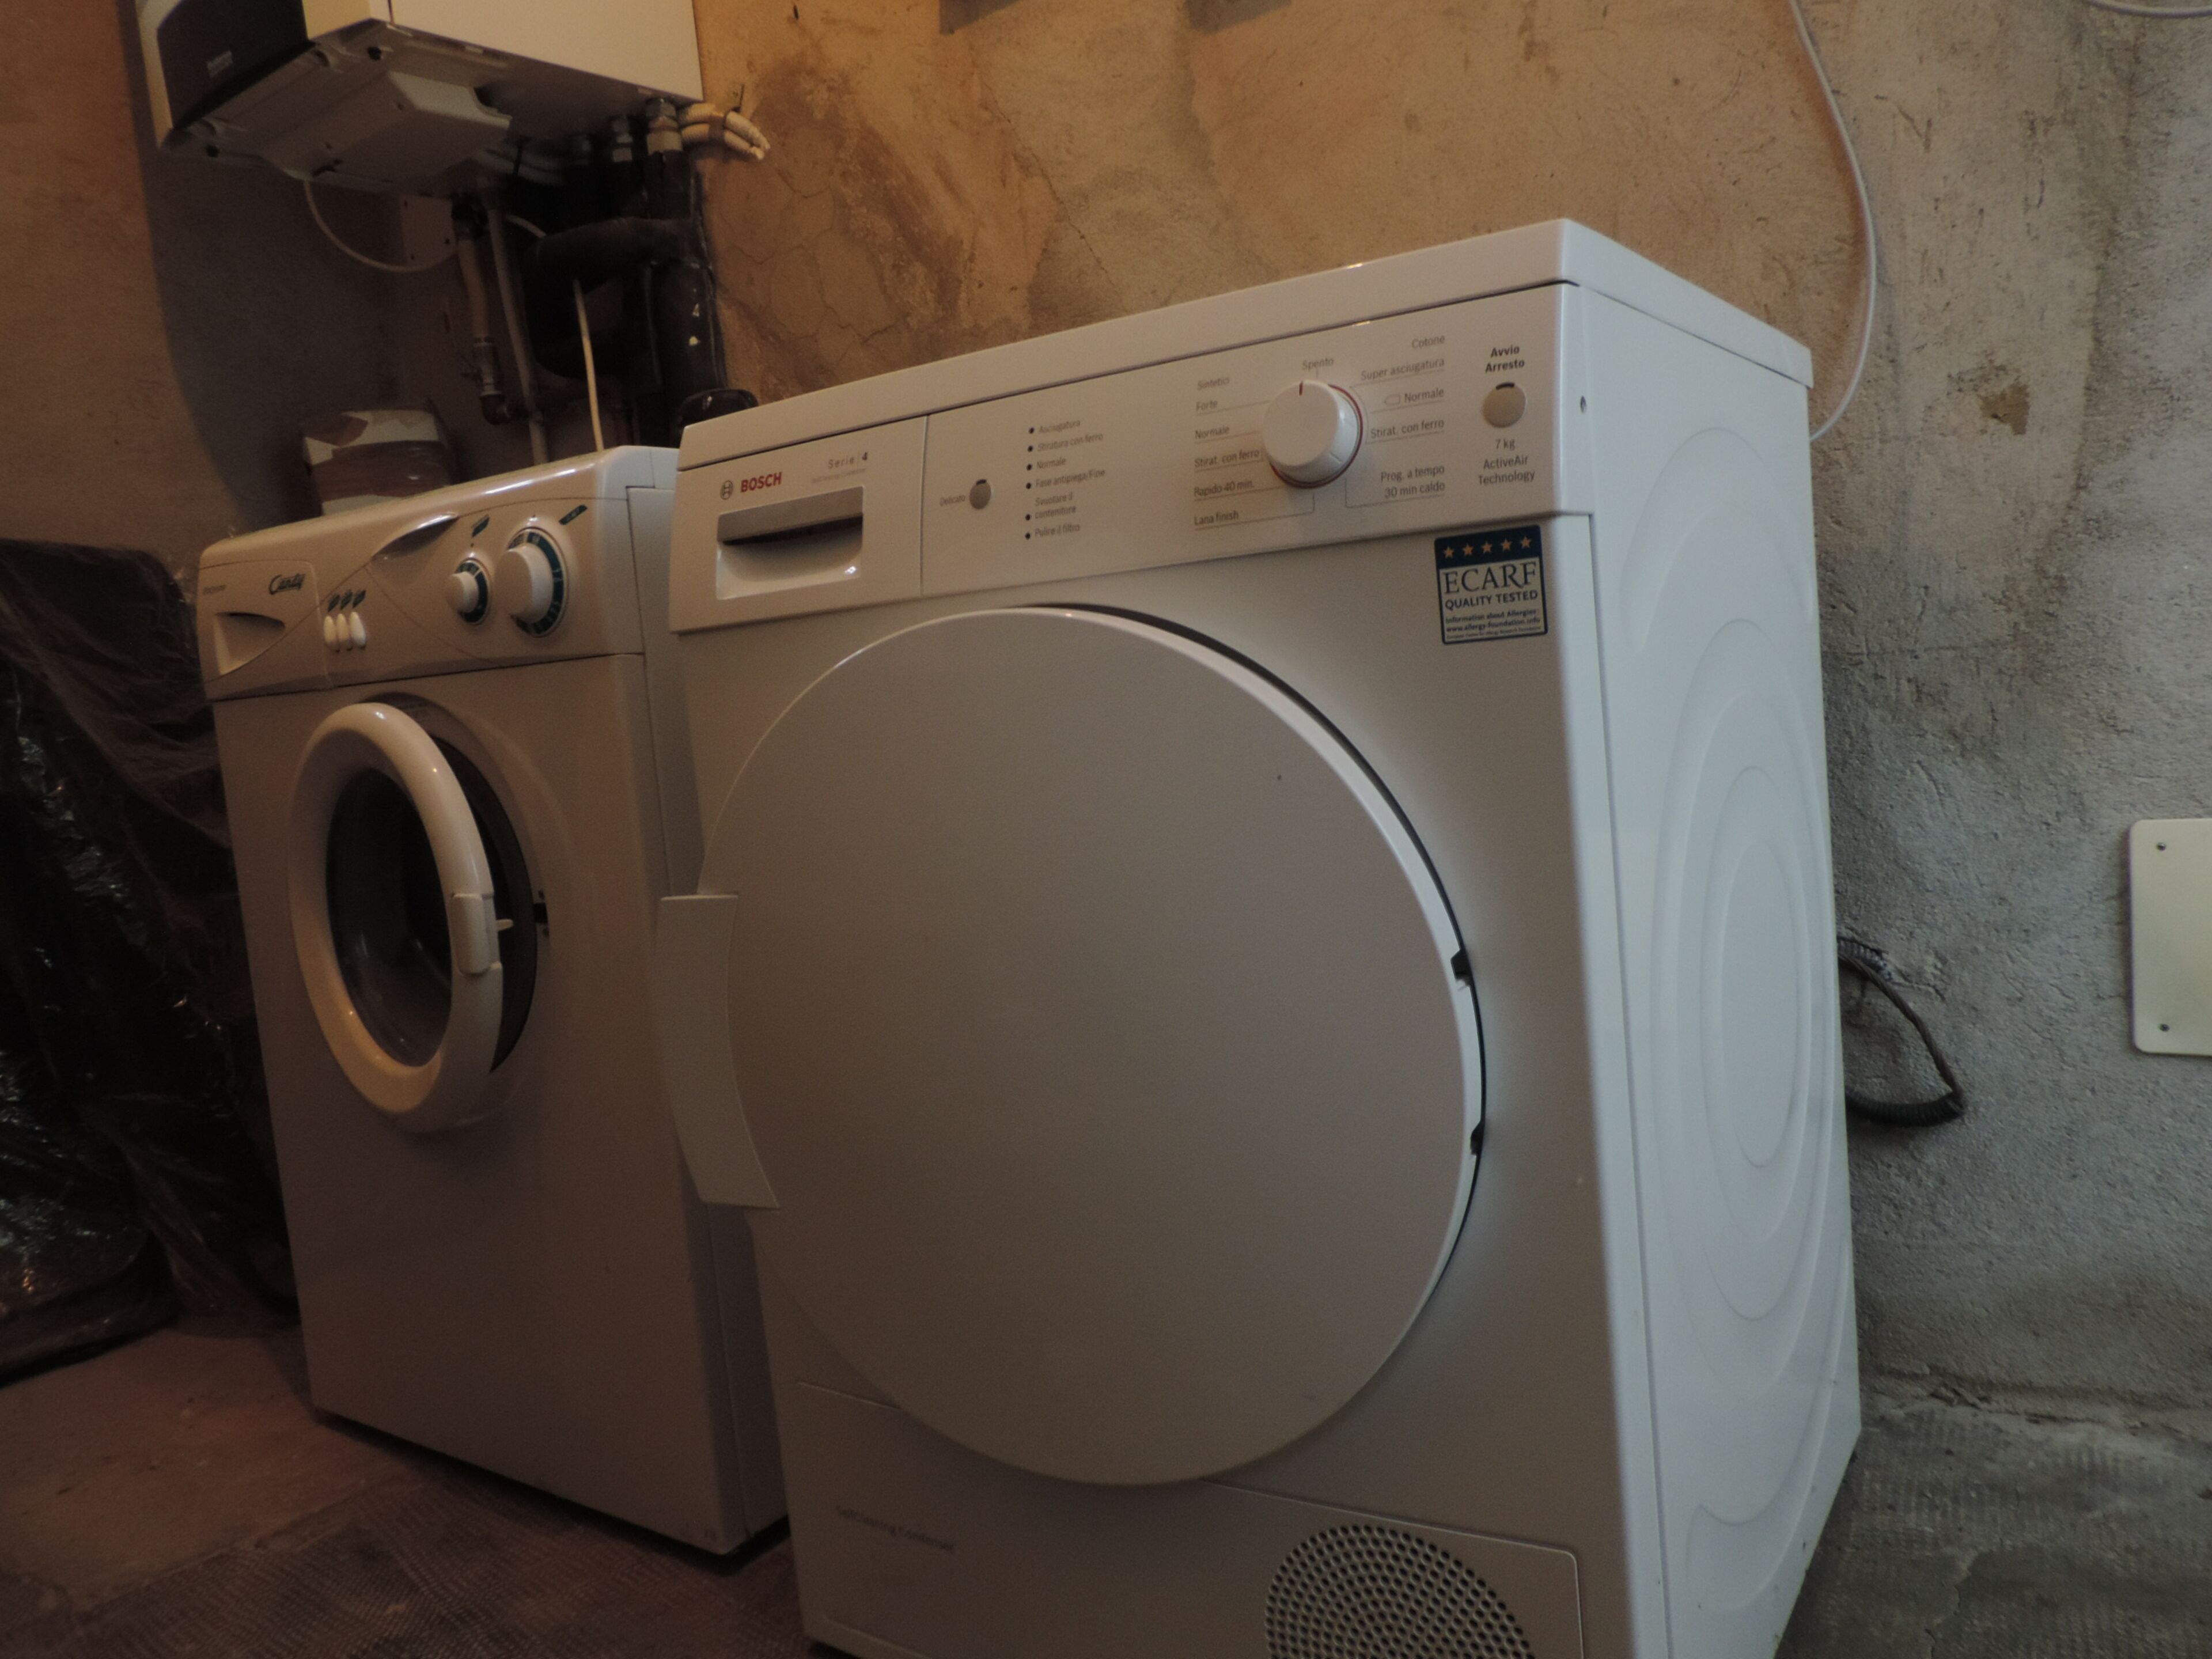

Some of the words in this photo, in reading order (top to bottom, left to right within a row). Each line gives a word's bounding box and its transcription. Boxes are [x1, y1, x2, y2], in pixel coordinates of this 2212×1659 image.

[1412, 335, 1445, 349] Cotone
[1490, 345, 1520, 358] Avvio
[1302, 357, 1334, 371] Spento
[1361, 367, 1388, 381] Super
[1390, 358, 1445, 376] asciugatura
[1485, 359, 1525, 373] Arresto
[1197, 377, 1230, 390] Sintetici
[1404, 388, 1444, 402] Normale
[1196, 399, 1218, 411] Forte
[1195, 425, 1230, 440] Normale
[1401, 424, 1419, 434] con
[1421, 419, 1444, 430] ferro
[1037, 440, 1069, 452] Stiratura
[1070, 437, 1084, 446] con
[1085, 433, 1104, 444] ferro
[1495, 439, 1501, 449] 7
[1503, 438, 1516, 451] kg
[828, 456, 854, 469] Serie
[861, 451, 869, 461] 4
[1037, 456, 1066, 469] Normale
[1222, 453, 1237, 464] con
[1239, 449, 1260, 460] ferro
[1483, 454, 1528, 470] ActiveAir
[1407, 471, 1413, 479] a
[1415, 465, 1445, 479] tempo
[1478, 470, 1535, 486] Technology
[740, 472, 782, 493] BOSCH
[1035, 477, 1052, 488] Fase
[1194, 482, 1223, 497] Rapido
[1225, 480, 1235, 491] 40
[1237, 479, 1253, 490] min
[1385, 487, 1397, 499] 30
[1400, 484, 1417, 495] min
[1419, 481, 1445, 493] caldo
[940, 494, 966, 507] Delicato
[1035, 494, 1066, 506] Svuotare
[1194, 514, 1214, 525] Lana
[1215, 509, 1239, 522] finish
[1035, 527, 1055, 538] Pulire
[1063, 523, 1080, 535] filtro
[1443, 561, 1536, 594] ECARF
[1445, 595, 1493, 611] QUALITY
[1495, 590, 1538, 604] TESTED
[1446, 612, 1485, 624] Information
[1486, 611, 1505, 620] about
